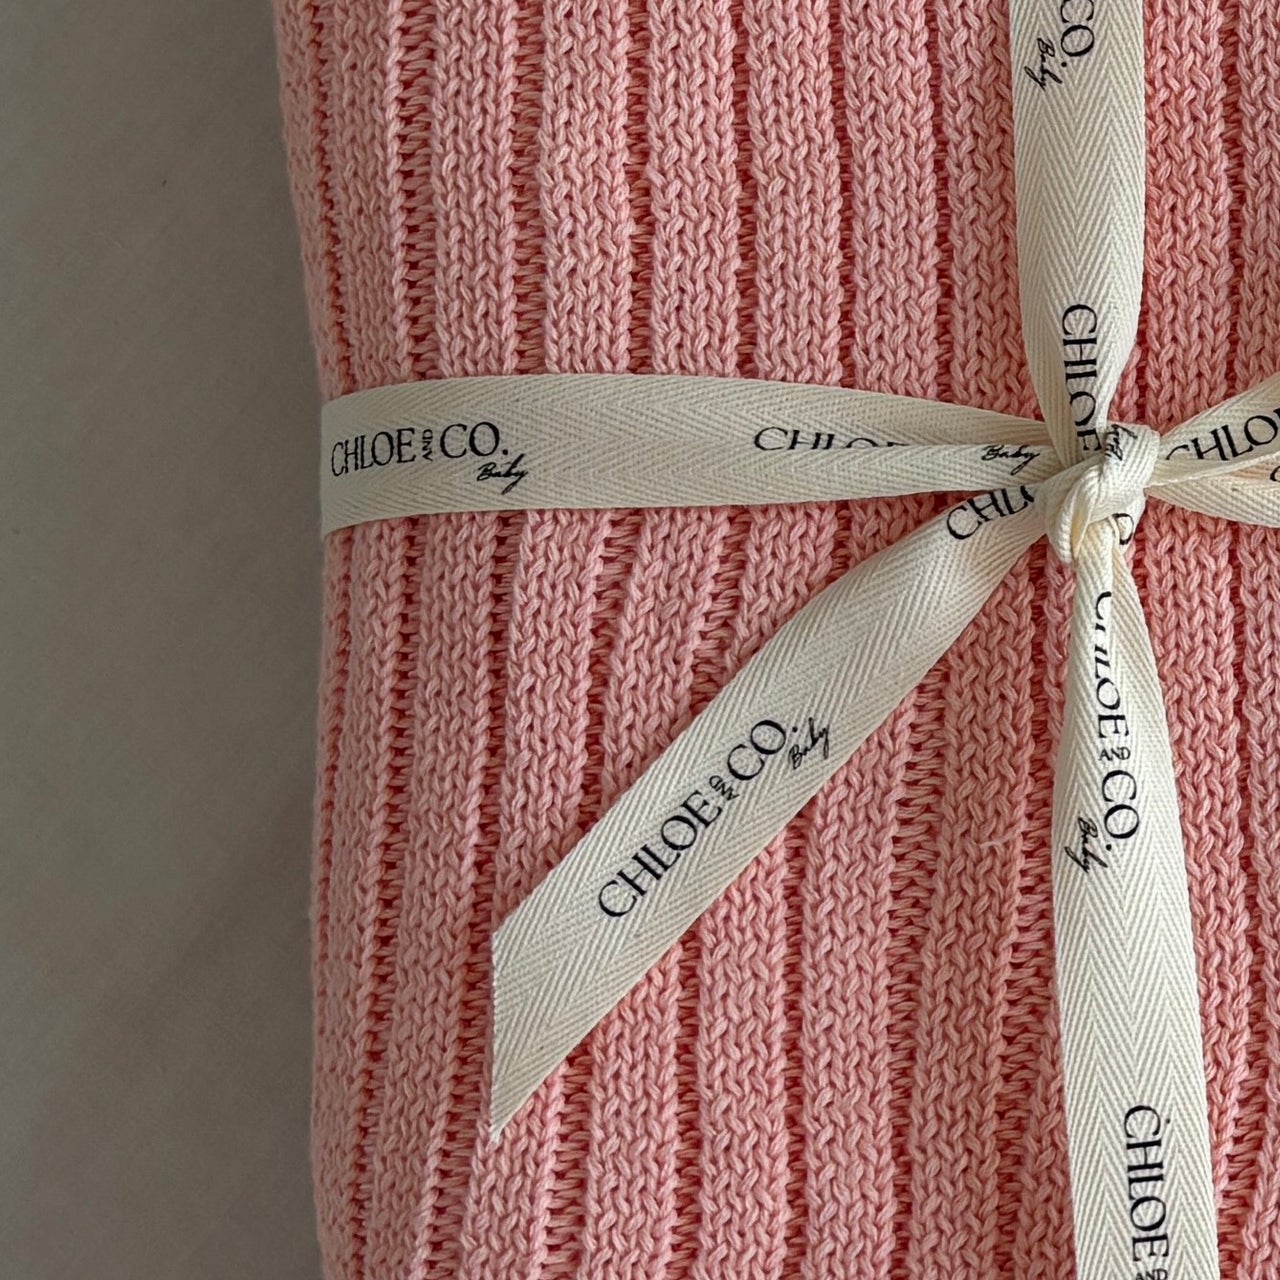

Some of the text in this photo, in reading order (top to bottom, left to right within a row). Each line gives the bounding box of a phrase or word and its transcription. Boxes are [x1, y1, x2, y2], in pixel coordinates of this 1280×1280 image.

[1024, 37, 1062, 91] Baby
[331, 422, 509, 477] CHLOE AND CO.
[476, 453, 529, 495] Baby
[788, 717, 830, 769] Baby
[1099, 747, 1131, 761] AND
[599, 720, 798, 917] CHLOE AND CO.
[1101, 770, 1140, 851] CO.
[1065, 815, 1108, 873] Baby
[1124, 1105, 1169, 1261] CHLOE
